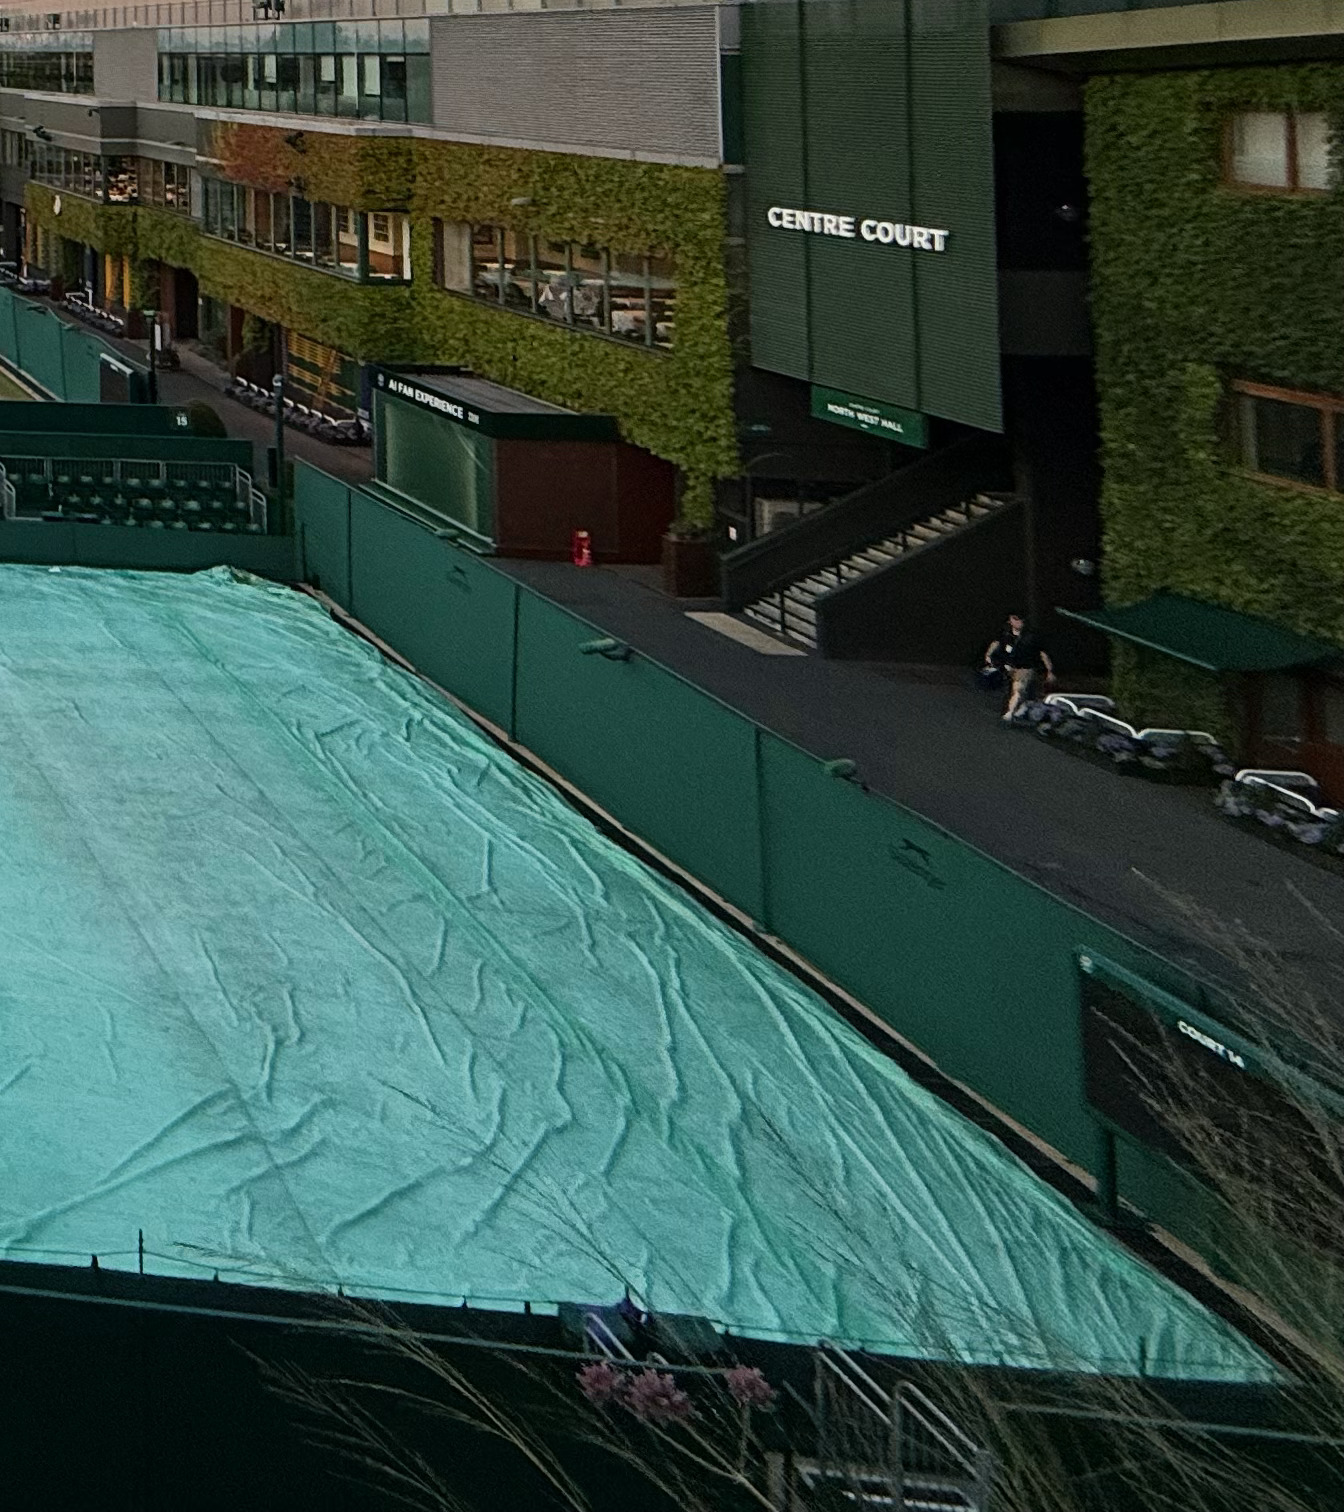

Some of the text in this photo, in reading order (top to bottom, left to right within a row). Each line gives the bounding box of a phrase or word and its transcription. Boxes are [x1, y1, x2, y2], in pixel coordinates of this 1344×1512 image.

[767, 206, 949, 252] CENTRE COURT
[398, 382, 414, 398] FAN
[415, 389, 464, 420] EXPERIENCE
[827, 403, 855, 419] NORTH
[856, 411, 880, 426] WEST
[881, 418, 904, 433] HALL
